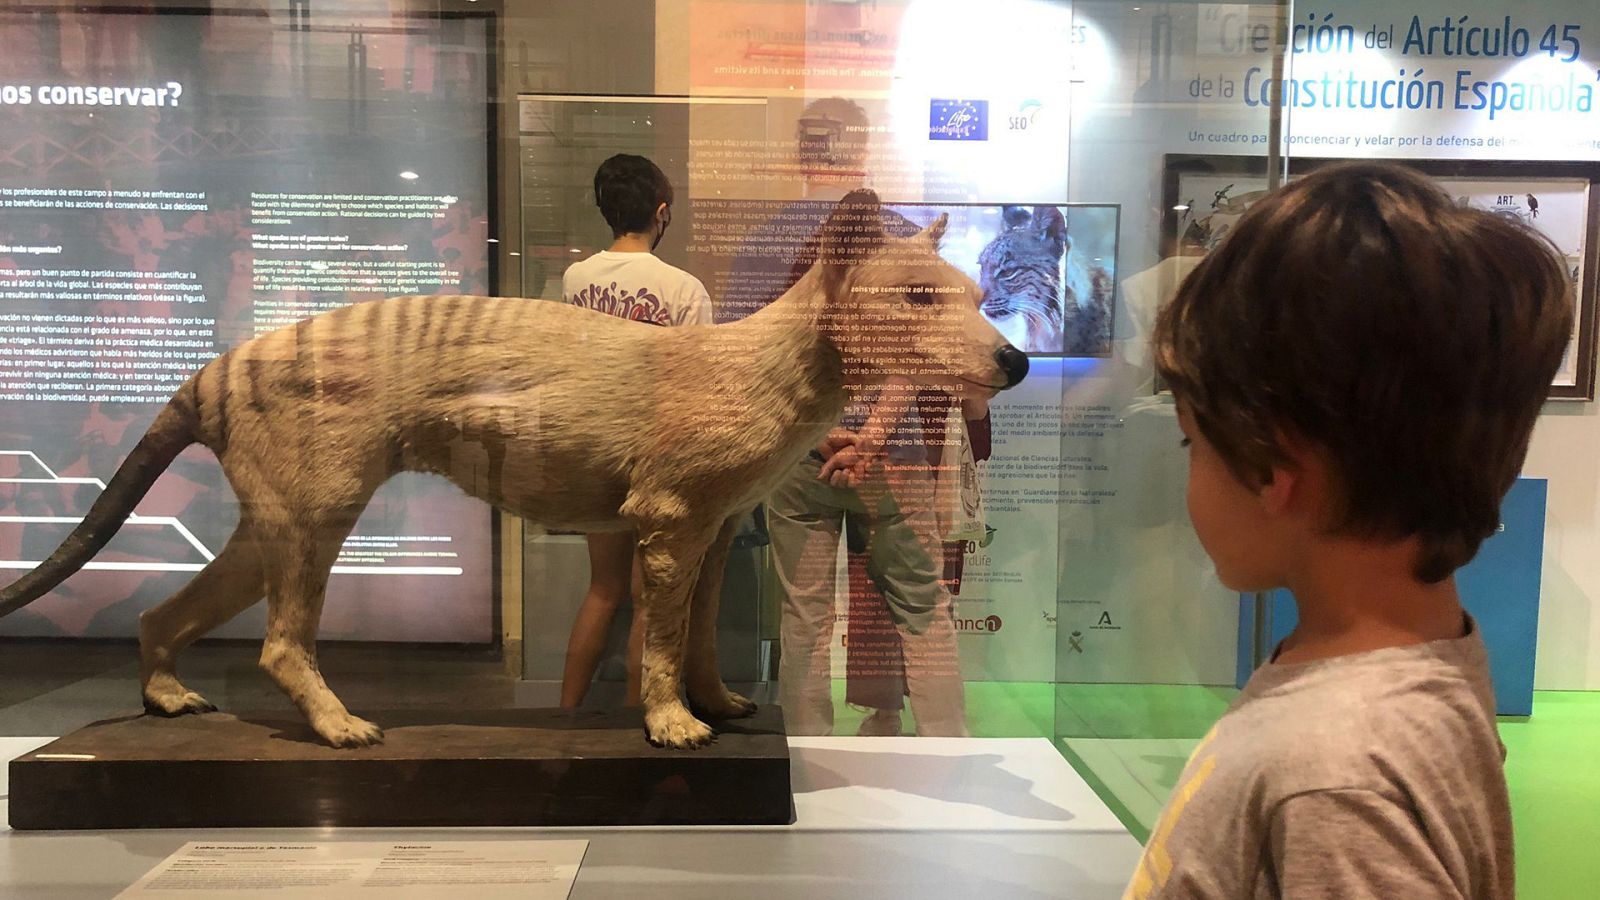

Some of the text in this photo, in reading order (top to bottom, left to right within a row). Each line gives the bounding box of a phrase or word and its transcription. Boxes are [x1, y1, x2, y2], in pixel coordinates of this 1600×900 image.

[1364, 24, 1393, 49] del
[1402, 15, 1529, 57] Artículo
[1539, 24, 1581, 62] 45
[1189, 73, 1212, 98] de
[1219, 73, 1234, 98] la
[0, 82, 182, 106] os conservar?
[1009, 117, 1027, 130] SEO
[1189, 131, 1204, 142] Un
[1208, 132, 1248, 144] cuadro
[1252, 135, 1267, 145] pa
[1284, 133, 1350, 145] concienciar
[1354, 136, 1360, 147] y
[1365, 134, 1395, 146] velar
[1398, 136, 1417, 147] por
[1422, 135, 1432, 146] la
[1436, 135, 1483, 147] defensa
[1487, 136, 1504, 147] del
[3, 188, 12, 196] los
[14, 188, 57, 197] profesionales
[84, 190, 106, 198] campo
[114, 190, 141, 198] menudo
[151, 190, 184, 198] enfrentan
[65, 200, 74, 208] las
[114, 201, 159, 209] conservación.
[1497, 195, 1516, 206] ART.
[60, 270, 80, 278] punto
[81, 269, 89, 277] de
[91, 270, 115, 278] partida
[154, 271, 189, 279] cuantificar
[11, 279, 18, 287] al
[19, 279, 35, 287] árbol
[54, 280, 67, 288] vida
[69, 280, 90, 290] global.
[105, 282, 133, 290] especies
[134, 283, 147, 291] que
[164, 283, 202, 291] contribuyan
